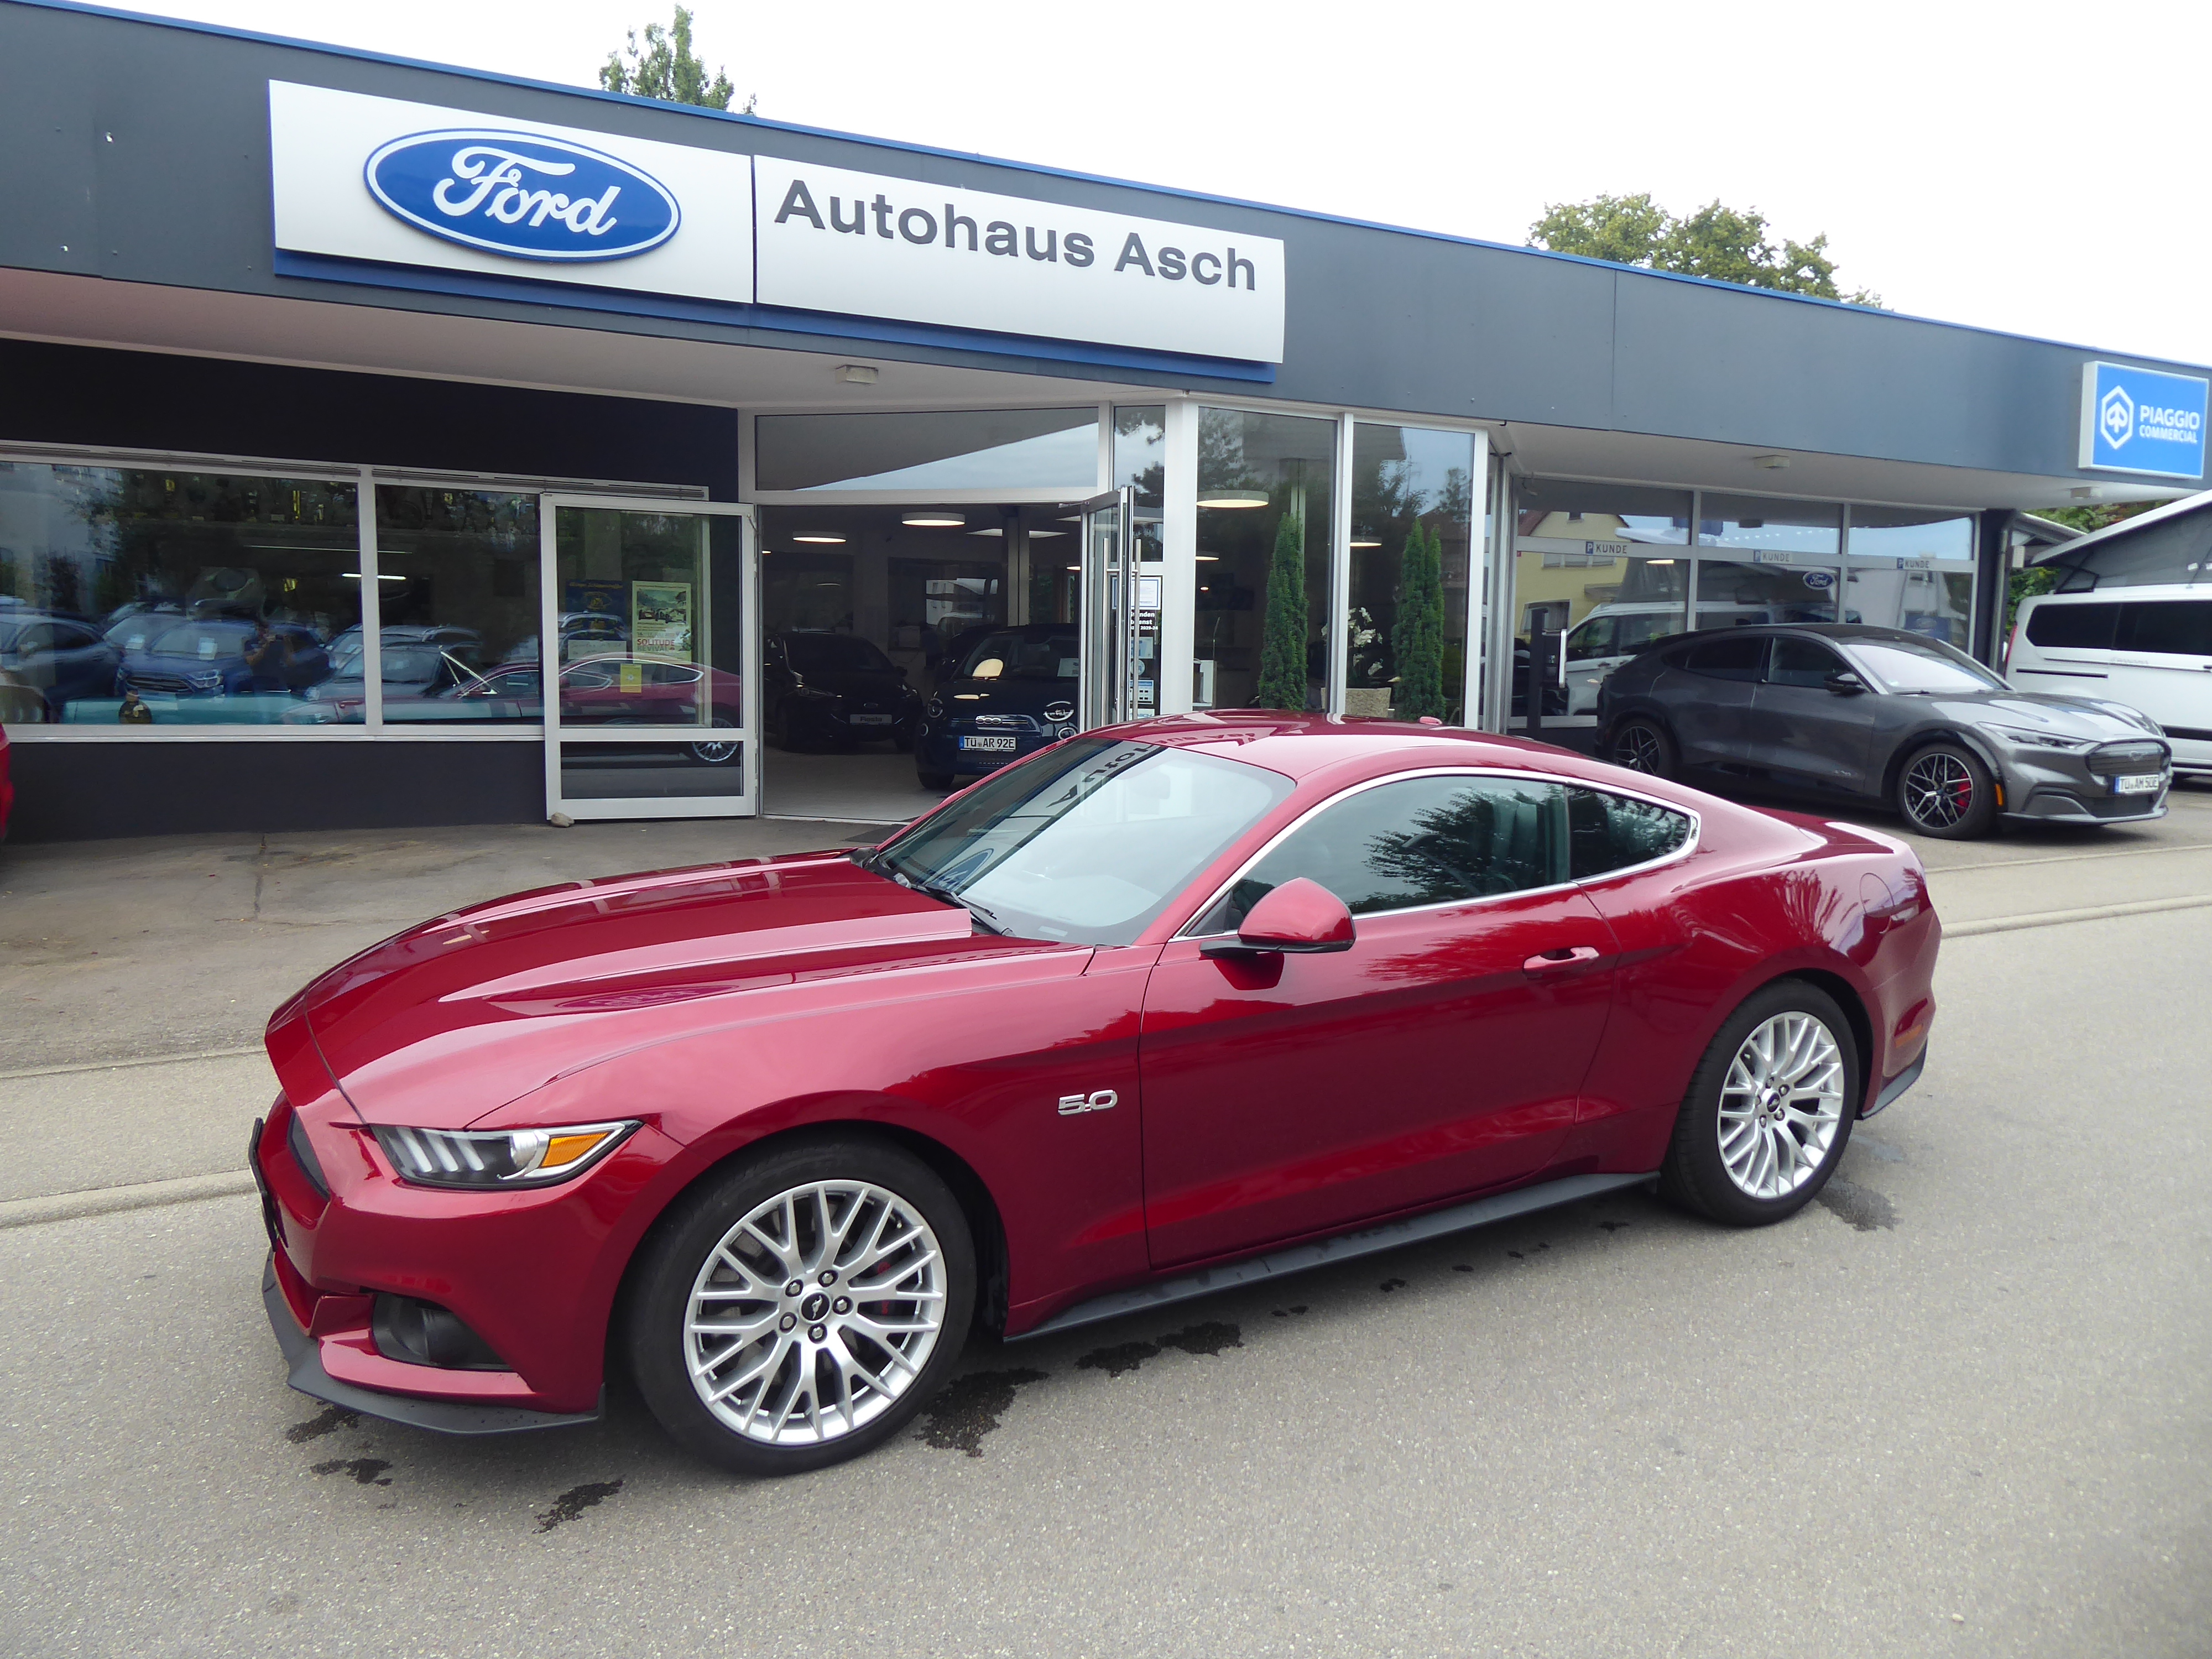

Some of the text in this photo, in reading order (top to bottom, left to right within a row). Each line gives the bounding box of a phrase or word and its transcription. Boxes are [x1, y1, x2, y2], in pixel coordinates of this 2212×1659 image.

[433, 147, 617, 236] Ford
[774, 179, 1256, 290] Autohaus Asch
[2140, 405, 2200, 430] PIAGGIO
[2139, 425, 2198, 444] COMMERCIAL
[1596, 544, 1627, 554] KUNDE
[1762, 553, 1790, 562] KUNDE
[1905, 560, 1930, 568] KUNDE
[1809, 574, 1829, 586] Ford
[975, 715, 1002, 724] 500
[964, 737, 1015, 748] TÜ AR 92E
[1058, 1089, 1118, 1115] 5.0
